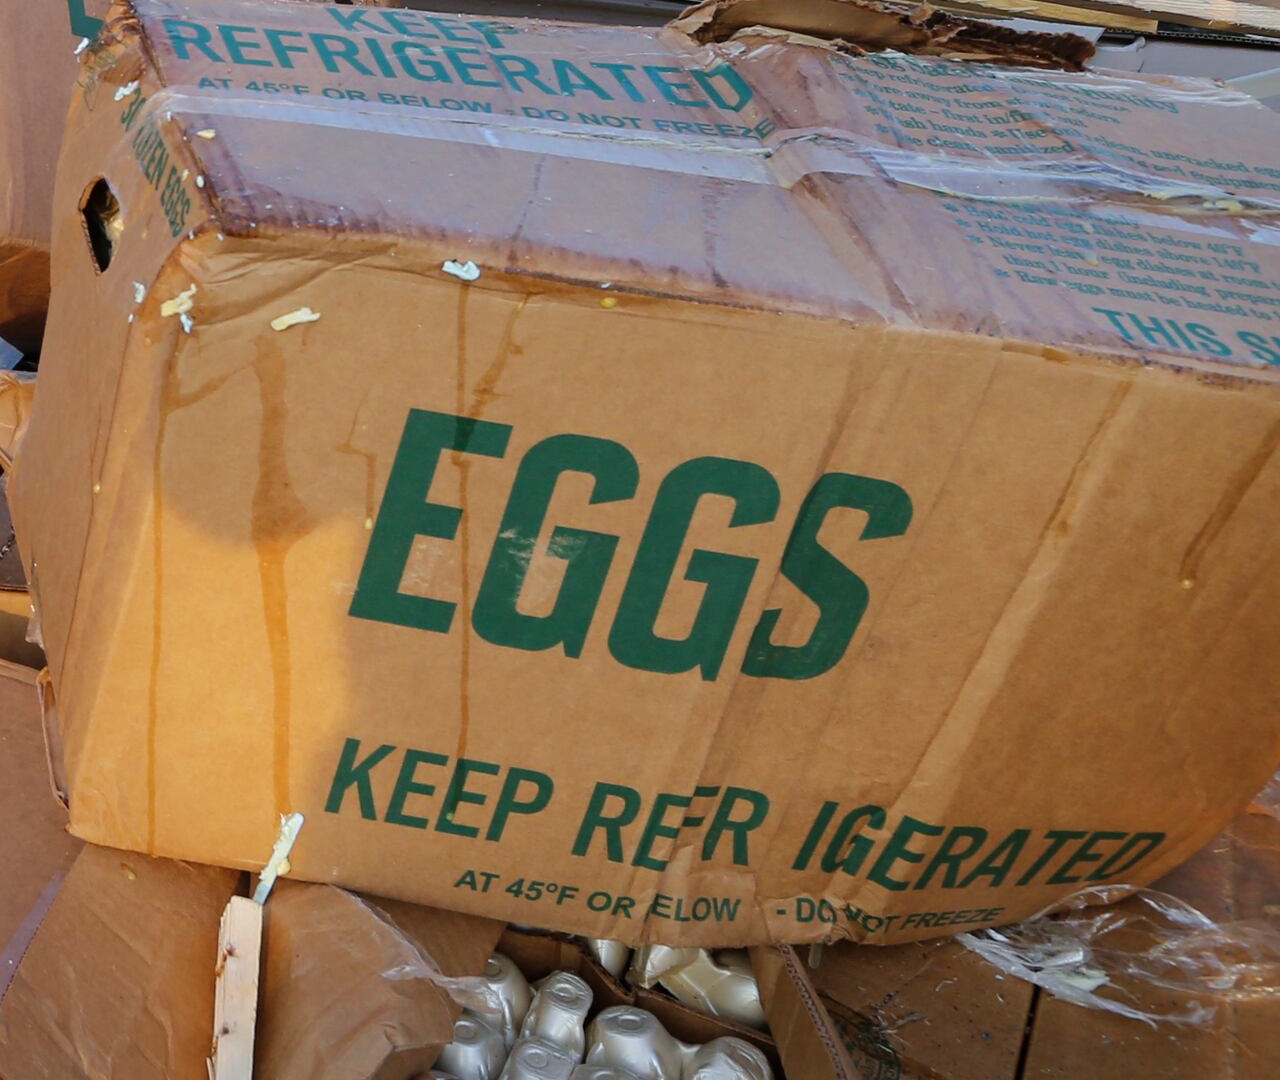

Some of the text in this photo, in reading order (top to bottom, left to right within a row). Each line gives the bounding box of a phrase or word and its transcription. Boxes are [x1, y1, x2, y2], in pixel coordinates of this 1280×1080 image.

[326, 6, 520, 48] KEEP
[162, 19, 754, 113] REFRIGERATED
[197, 77, 233, 90] AT
[322, 88, 369, 103] OR
[377, 92, 493, 115] BELOW
[523, 107, 570, 121] DO
[579, 114, 641, 129] NOT
[655, 118, 777, 140] FREEZE
[160, 166, 192, 238] EGGS
[1092, 307, 1280, 367] THIS S
[348, 407, 914, 682] EGGS
[324, 736, 554, 842] KEEP
[454, 869, 503, 898] AT
[505, 875, 579, 908] 45°F
[586, 890, 637, 920] OR
[649, 892, 742, 922] ELOW
[898, 906, 1005, 932] FREEZE
